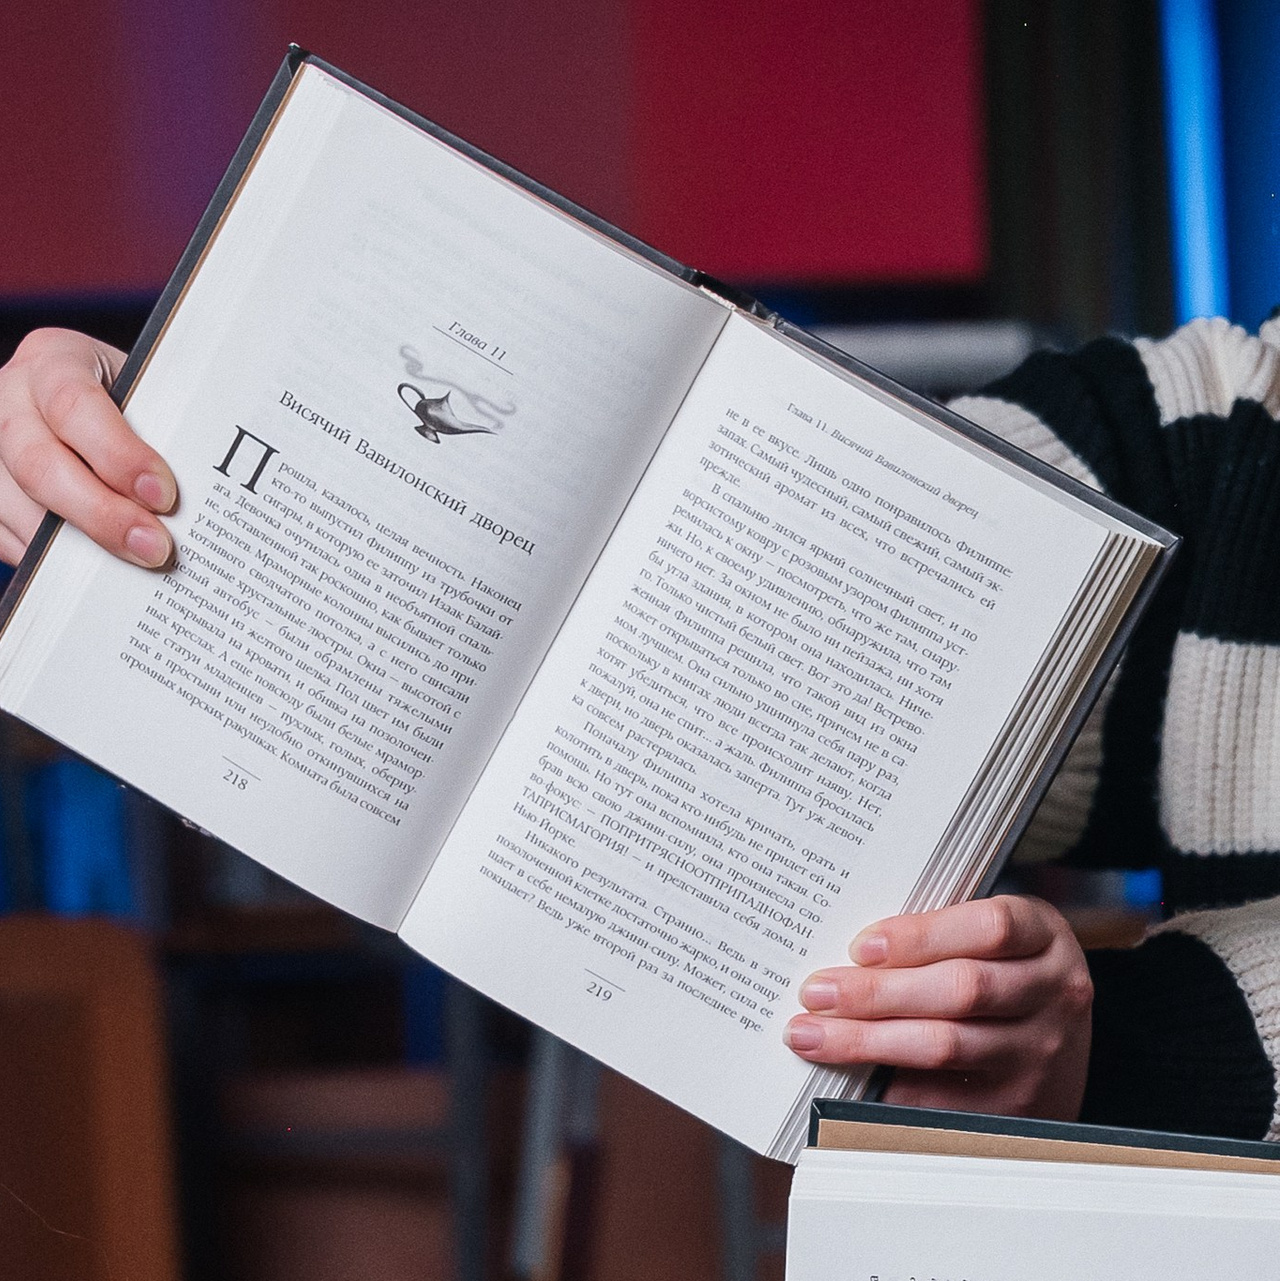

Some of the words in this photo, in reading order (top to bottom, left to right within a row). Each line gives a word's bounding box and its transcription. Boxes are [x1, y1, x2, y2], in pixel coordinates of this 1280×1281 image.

[447, 320, 488, 350] Глава
[489, 345, 507, 361] 11
[278, 389, 351, 445] Висячий
[353, 437, 467, 516] Вавилонский
[468, 511, 536, 556] дворец
[724, 407, 740, 421] не
[740, 417, 750, 428] в
[751, 424, 766, 437] ее
[766, 433, 800, 459] вкусе.
[802, 453, 837, 480] Лишь
[840, 477, 871, 499] одно
[873, 495, 951, 544] понравилось
[955, 540, 1013, 578] Филиппе:
[786, 401, 813, 424] Глава
[814, 418, 828, 433] 11.
[829, 428, 874, 458] Висячий
[873, 453, 941, 496] Вавилонский
[940, 490, 979, 520] дворец
[193, 512, 206, 524] у
[204, 518, 251, 554] королев.
[253, 547, 323, 597] Мраморные
[322, 593, 374, 630] колонны
[374, 625, 431, 663] высились
[431, 658, 449, 673] до
[449, 668, 477, 686] при-
[211, 481, 231, 499] ага.
[233, 494, 282, 530] Девочка
[283, 527, 340, 568] очутилась
[342, 564, 372, 587] одна
[373, 583, 383, 593] в
[384, 589, 456, 636] необъятной
[457, 632, 494, 655] спаль-
[270, 476, 307, 504] кто-то
[308, 501, 364, 540] выпустил
[365, 536, 420, 575] Филиппу
[420, 570, 437, 584] из
[439, 580, 496, 618] трубочки
[497, 613, 514, 626] от
[320, 487, 371, 526] казалось,
[374, 521, 410, 548] целая
[410, 543, 465, 582] вечность.
[469, 576, 522, 612] Наконец
[681, 487, 747, 533] ворсистому
[745, 526, 782, 554] ковру
[780, 548, 790, 557] с
[787, 552, 844, 588] розовым
[840, 582, 889, 614] узором
[888, 607, 944, 644] Филиппа
[941, 638, 968, 656] уст-
[221, 768, 248, 790] 218
[512, 800, 576, 848] Нью-Йорке.
[521, 785, 630, 857] ТАПРИСМАГОРИЯ!
[585, 980, 613, 1001] 219
